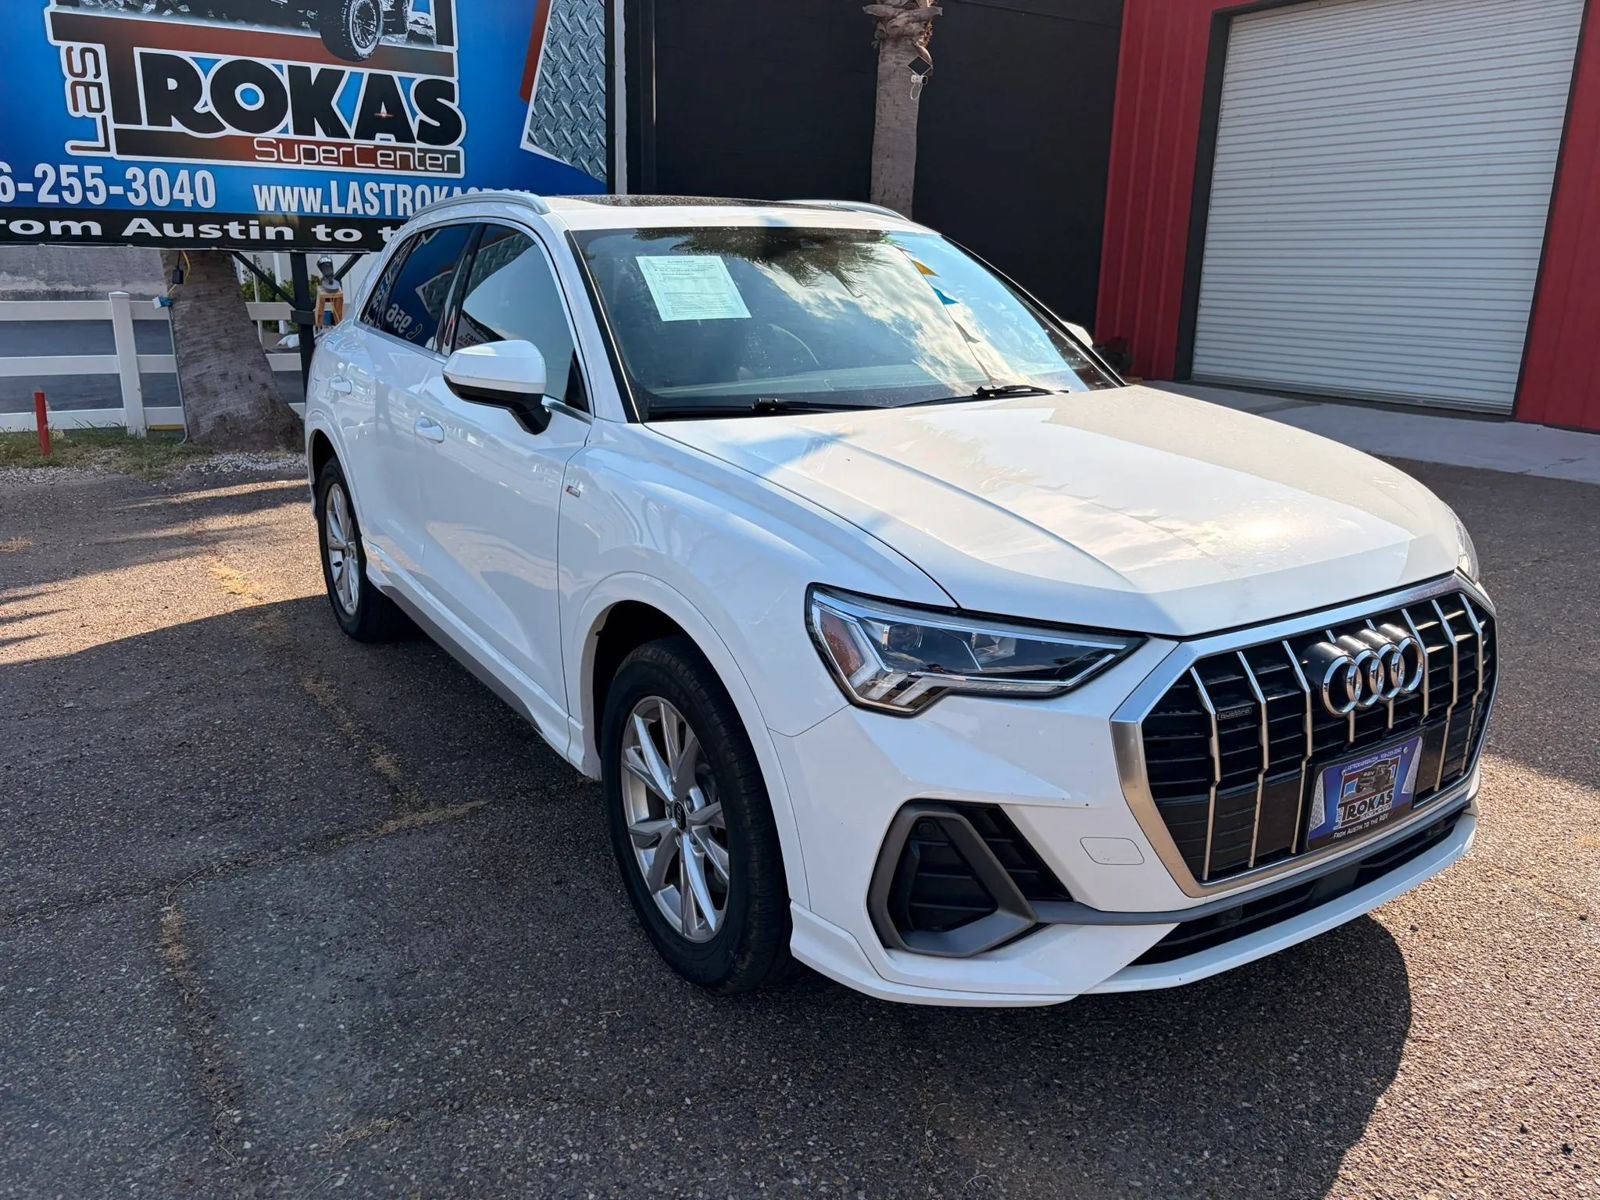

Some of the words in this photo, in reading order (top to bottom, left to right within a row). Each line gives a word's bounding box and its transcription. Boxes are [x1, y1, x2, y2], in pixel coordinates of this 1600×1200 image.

[50, 12, 464, 146] TROKAS
[253, 137, 457, 172] SuperCenter
[0, 219, 102, 236] om
[121, 217, 294, 241] Austin
[311, 224, 362, 242] to
[377, 224, 404, 242] t
[1338, 787, 1394, 821] TROKAS
